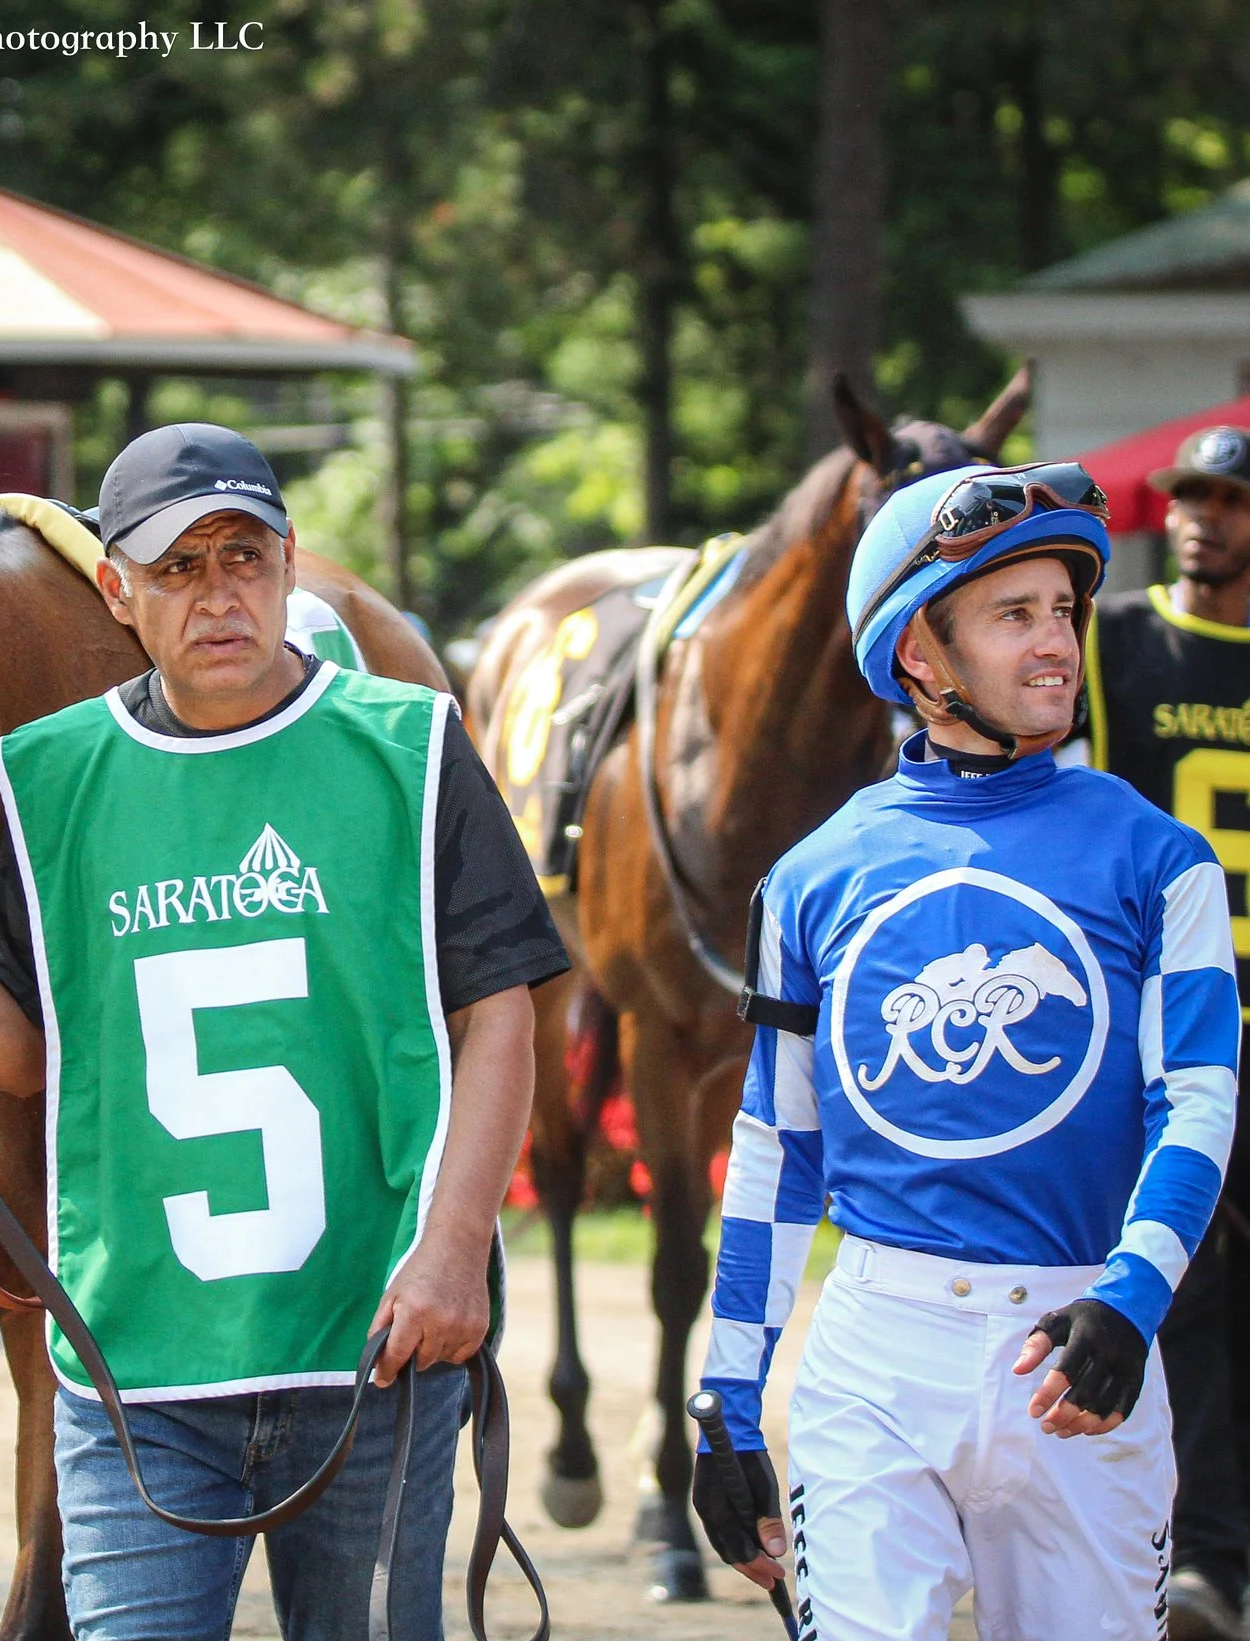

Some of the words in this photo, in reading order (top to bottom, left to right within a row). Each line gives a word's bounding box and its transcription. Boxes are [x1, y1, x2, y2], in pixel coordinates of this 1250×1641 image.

[227, 479, 272, 496] Columbia
[108, 866, 330, 937] SARATOGA
[857, 974, 1062, 1091] RCR
[134, 937, 327, 1282] 5
